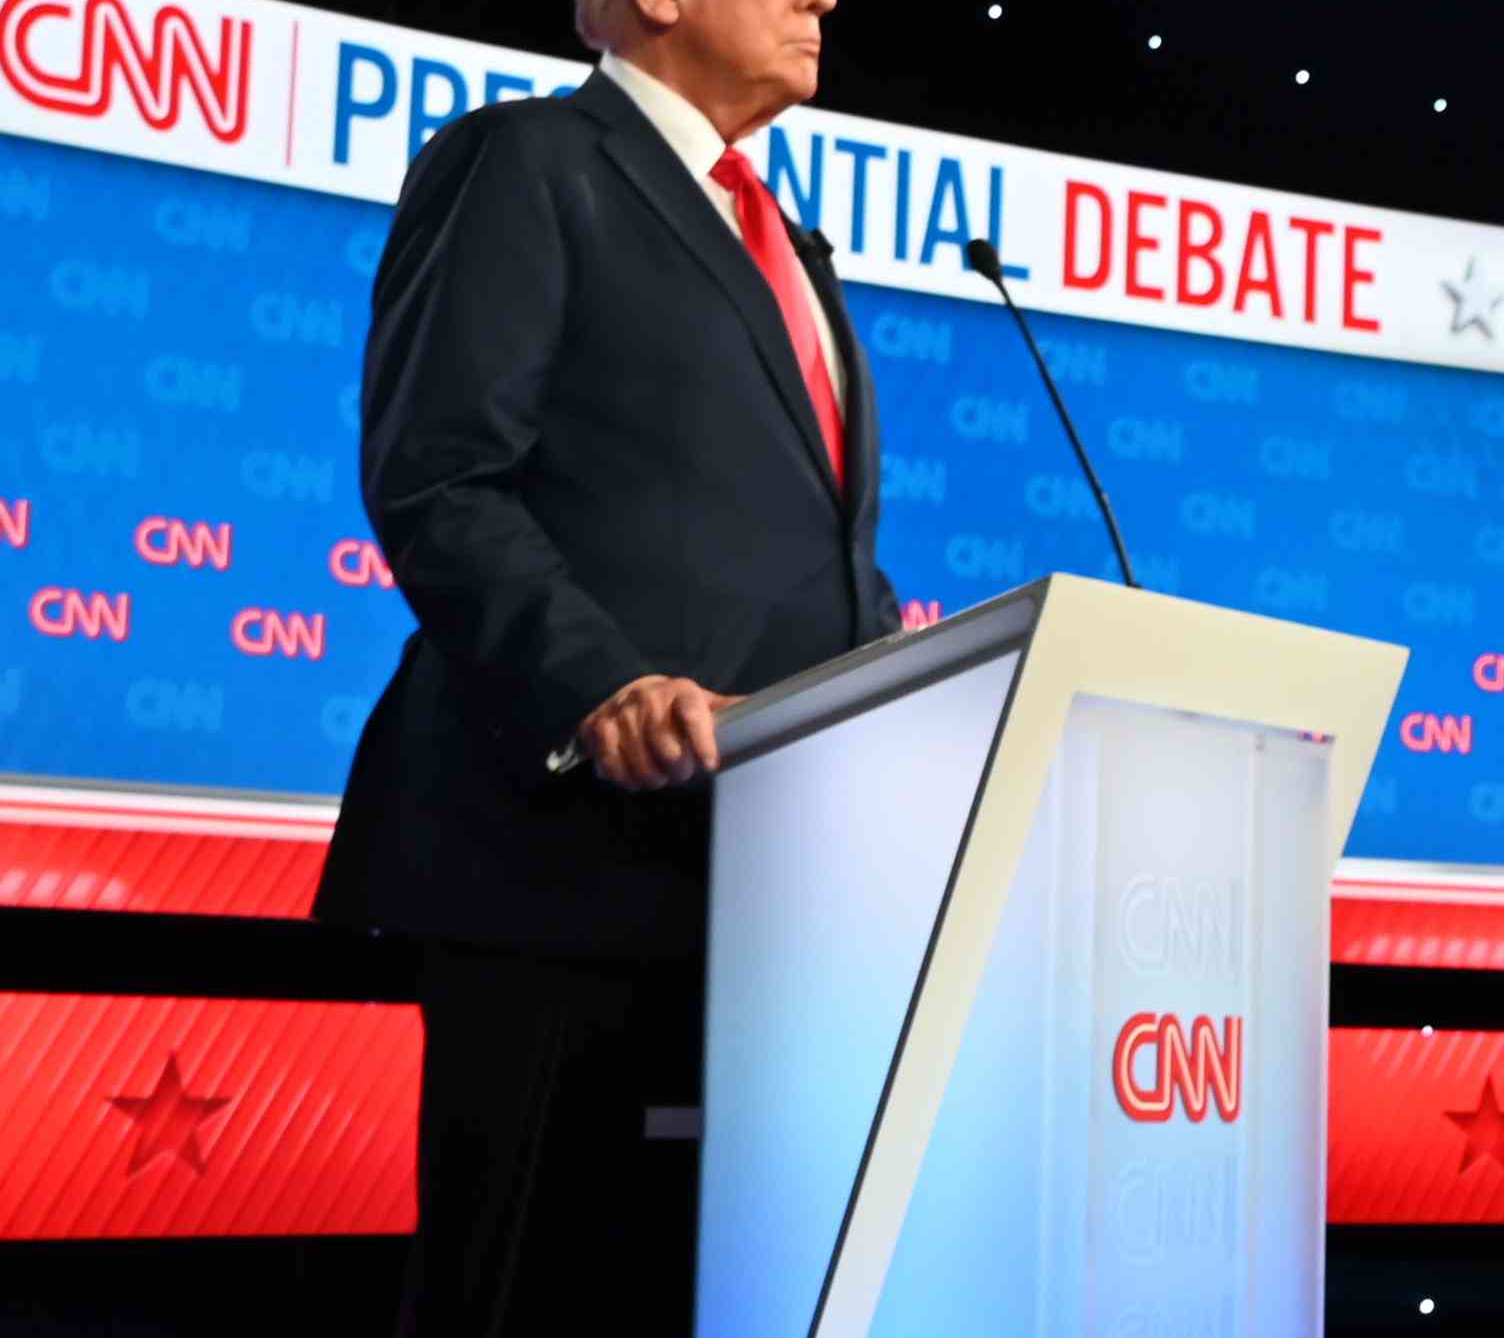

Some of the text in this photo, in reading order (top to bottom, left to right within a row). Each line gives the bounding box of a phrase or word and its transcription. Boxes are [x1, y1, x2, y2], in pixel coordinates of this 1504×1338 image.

[1062, 179, 1384, 334] DEBATE
[135, 517, 232, 570] CNN
[330, 539, 396, 589] CN
[29, 587, 131, 641] CNN
[232, 608, 326, 660] CNN
[1401, 713, 1472, 753] CNN
[1112, 1011, 1244, 1124] CNN
